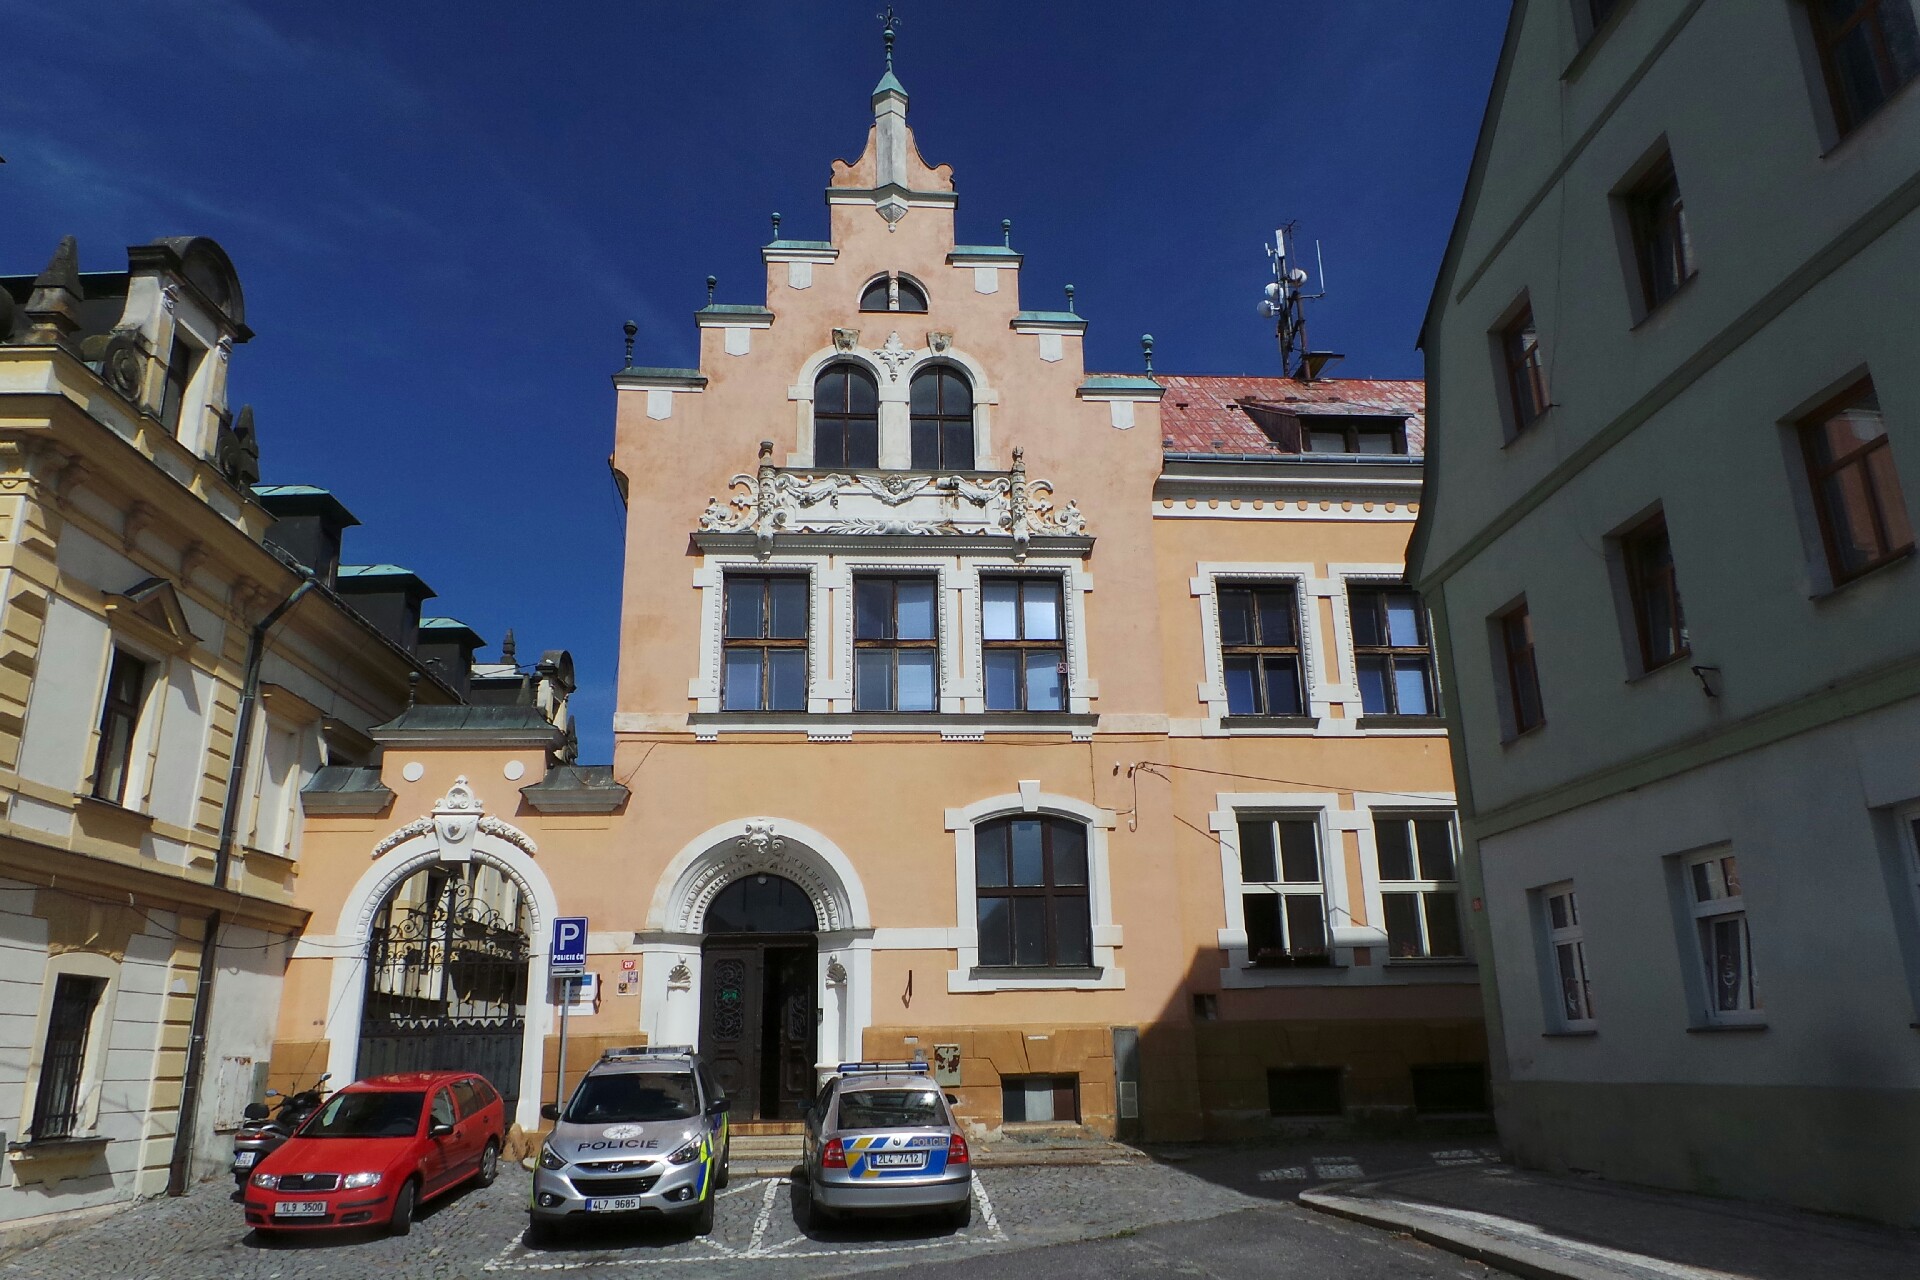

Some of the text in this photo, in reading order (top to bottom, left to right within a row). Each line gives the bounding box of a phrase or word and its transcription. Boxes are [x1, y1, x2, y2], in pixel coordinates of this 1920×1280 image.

[560, 924, 580, 950] P
[578, 1140, 658, 1152] POLICIE
[912, 1138, 947, 1147] POLICIE
[878, 1154, 919, 1164] 2L4 7412
[282, 1202, 322, 1212] 1L9 3500
[593, 1199, 635, 1209] 4L7 9685
